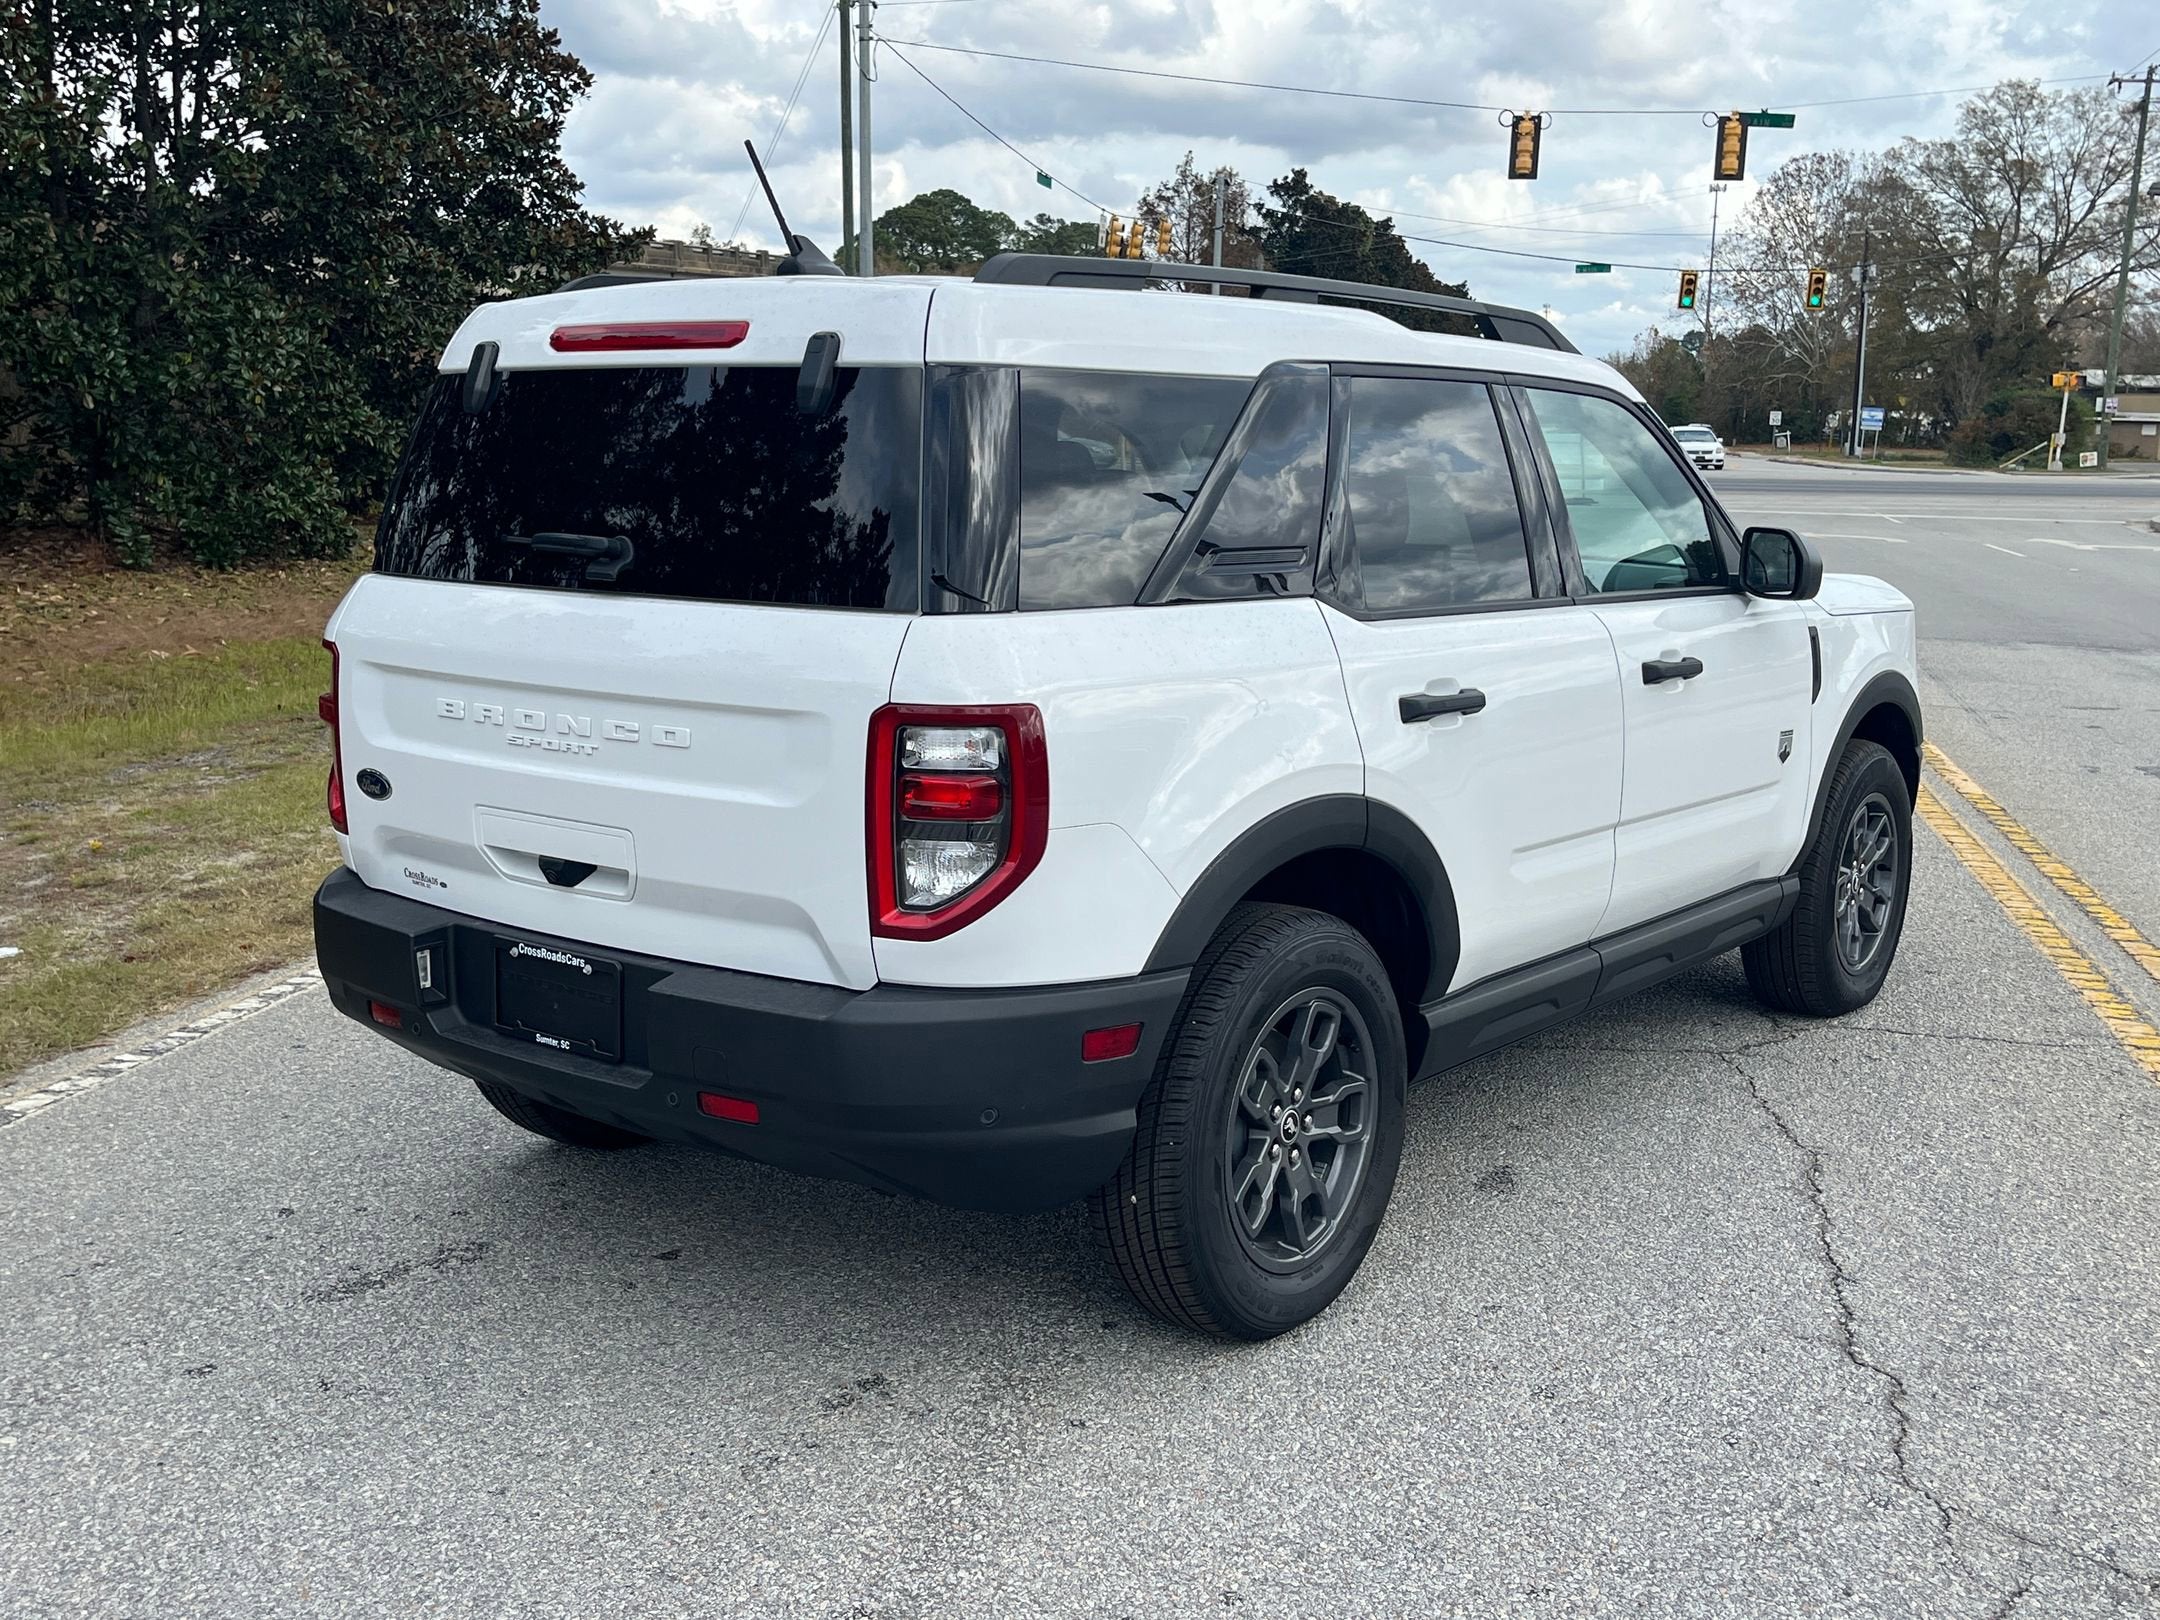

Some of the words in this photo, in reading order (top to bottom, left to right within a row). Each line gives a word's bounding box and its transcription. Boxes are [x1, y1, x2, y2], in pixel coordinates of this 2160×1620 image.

[437, 698, 691, 748] BRONCO
[505, 733, 599, 755] SPORT
[518, 943, 585, 968] CrossRoadsCars
[536, 1033, 560, 1048] Sumter,
[561, 1040, 571, 1050] SC
